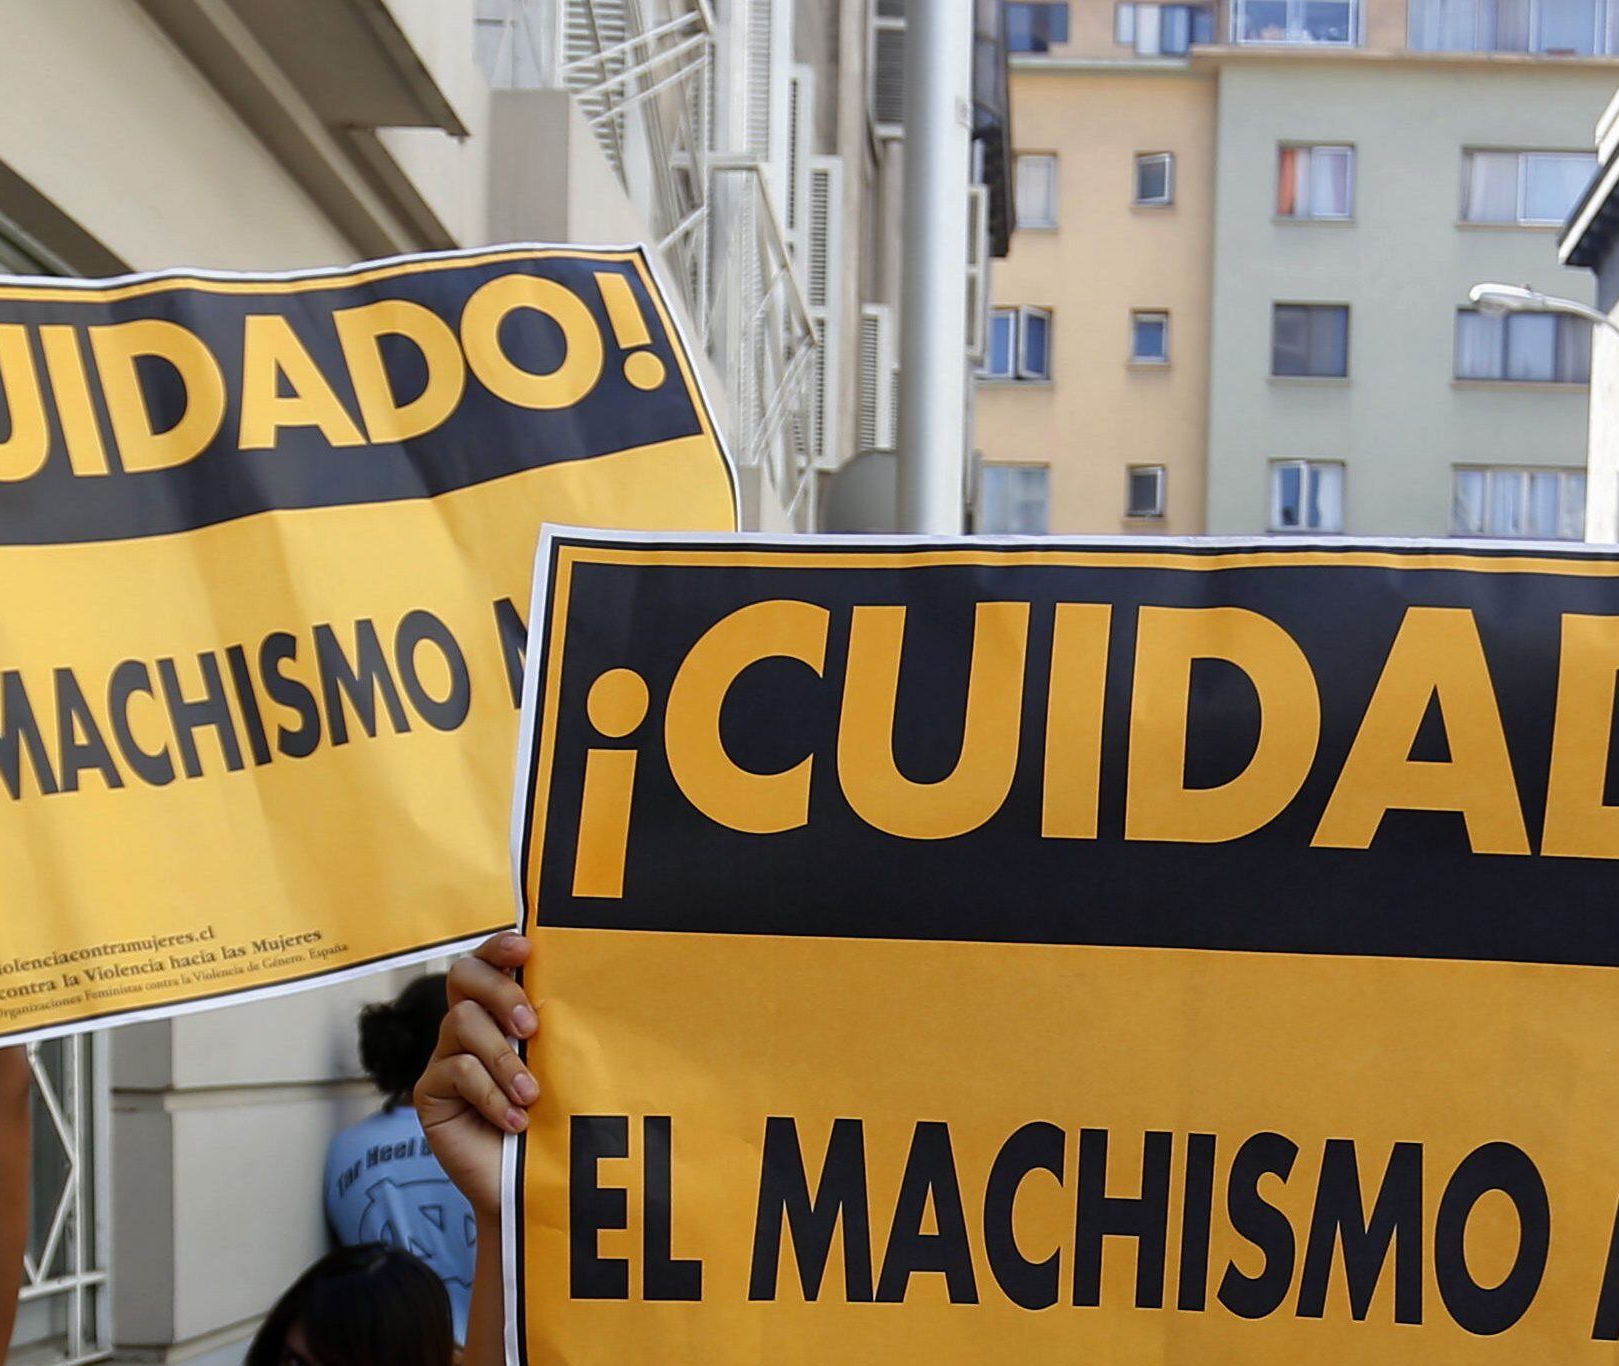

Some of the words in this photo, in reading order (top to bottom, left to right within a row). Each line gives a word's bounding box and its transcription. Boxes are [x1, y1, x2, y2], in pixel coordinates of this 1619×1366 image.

[63, 973, 80, 988] la
[84, 958, 165, 983] Violencia
[170, 952, 217, 969] hacia
[221, 945, 247, 961] las
[252, 928, 323, 955] Mujeres
[84, 981, 143, 1001] Feministas
[145, 976, 179, 991] contra
[181, 973, 191, 985] la
[192, 963, 245, 983] Violencia
[247, 959, 261, 973] de
[262, 953, 305, 969] Género.
[309, 942, 348, 962] España
[568, 1113, 704, 1303] EL
[747, 1115, 1551, 1338] MACHISMO
